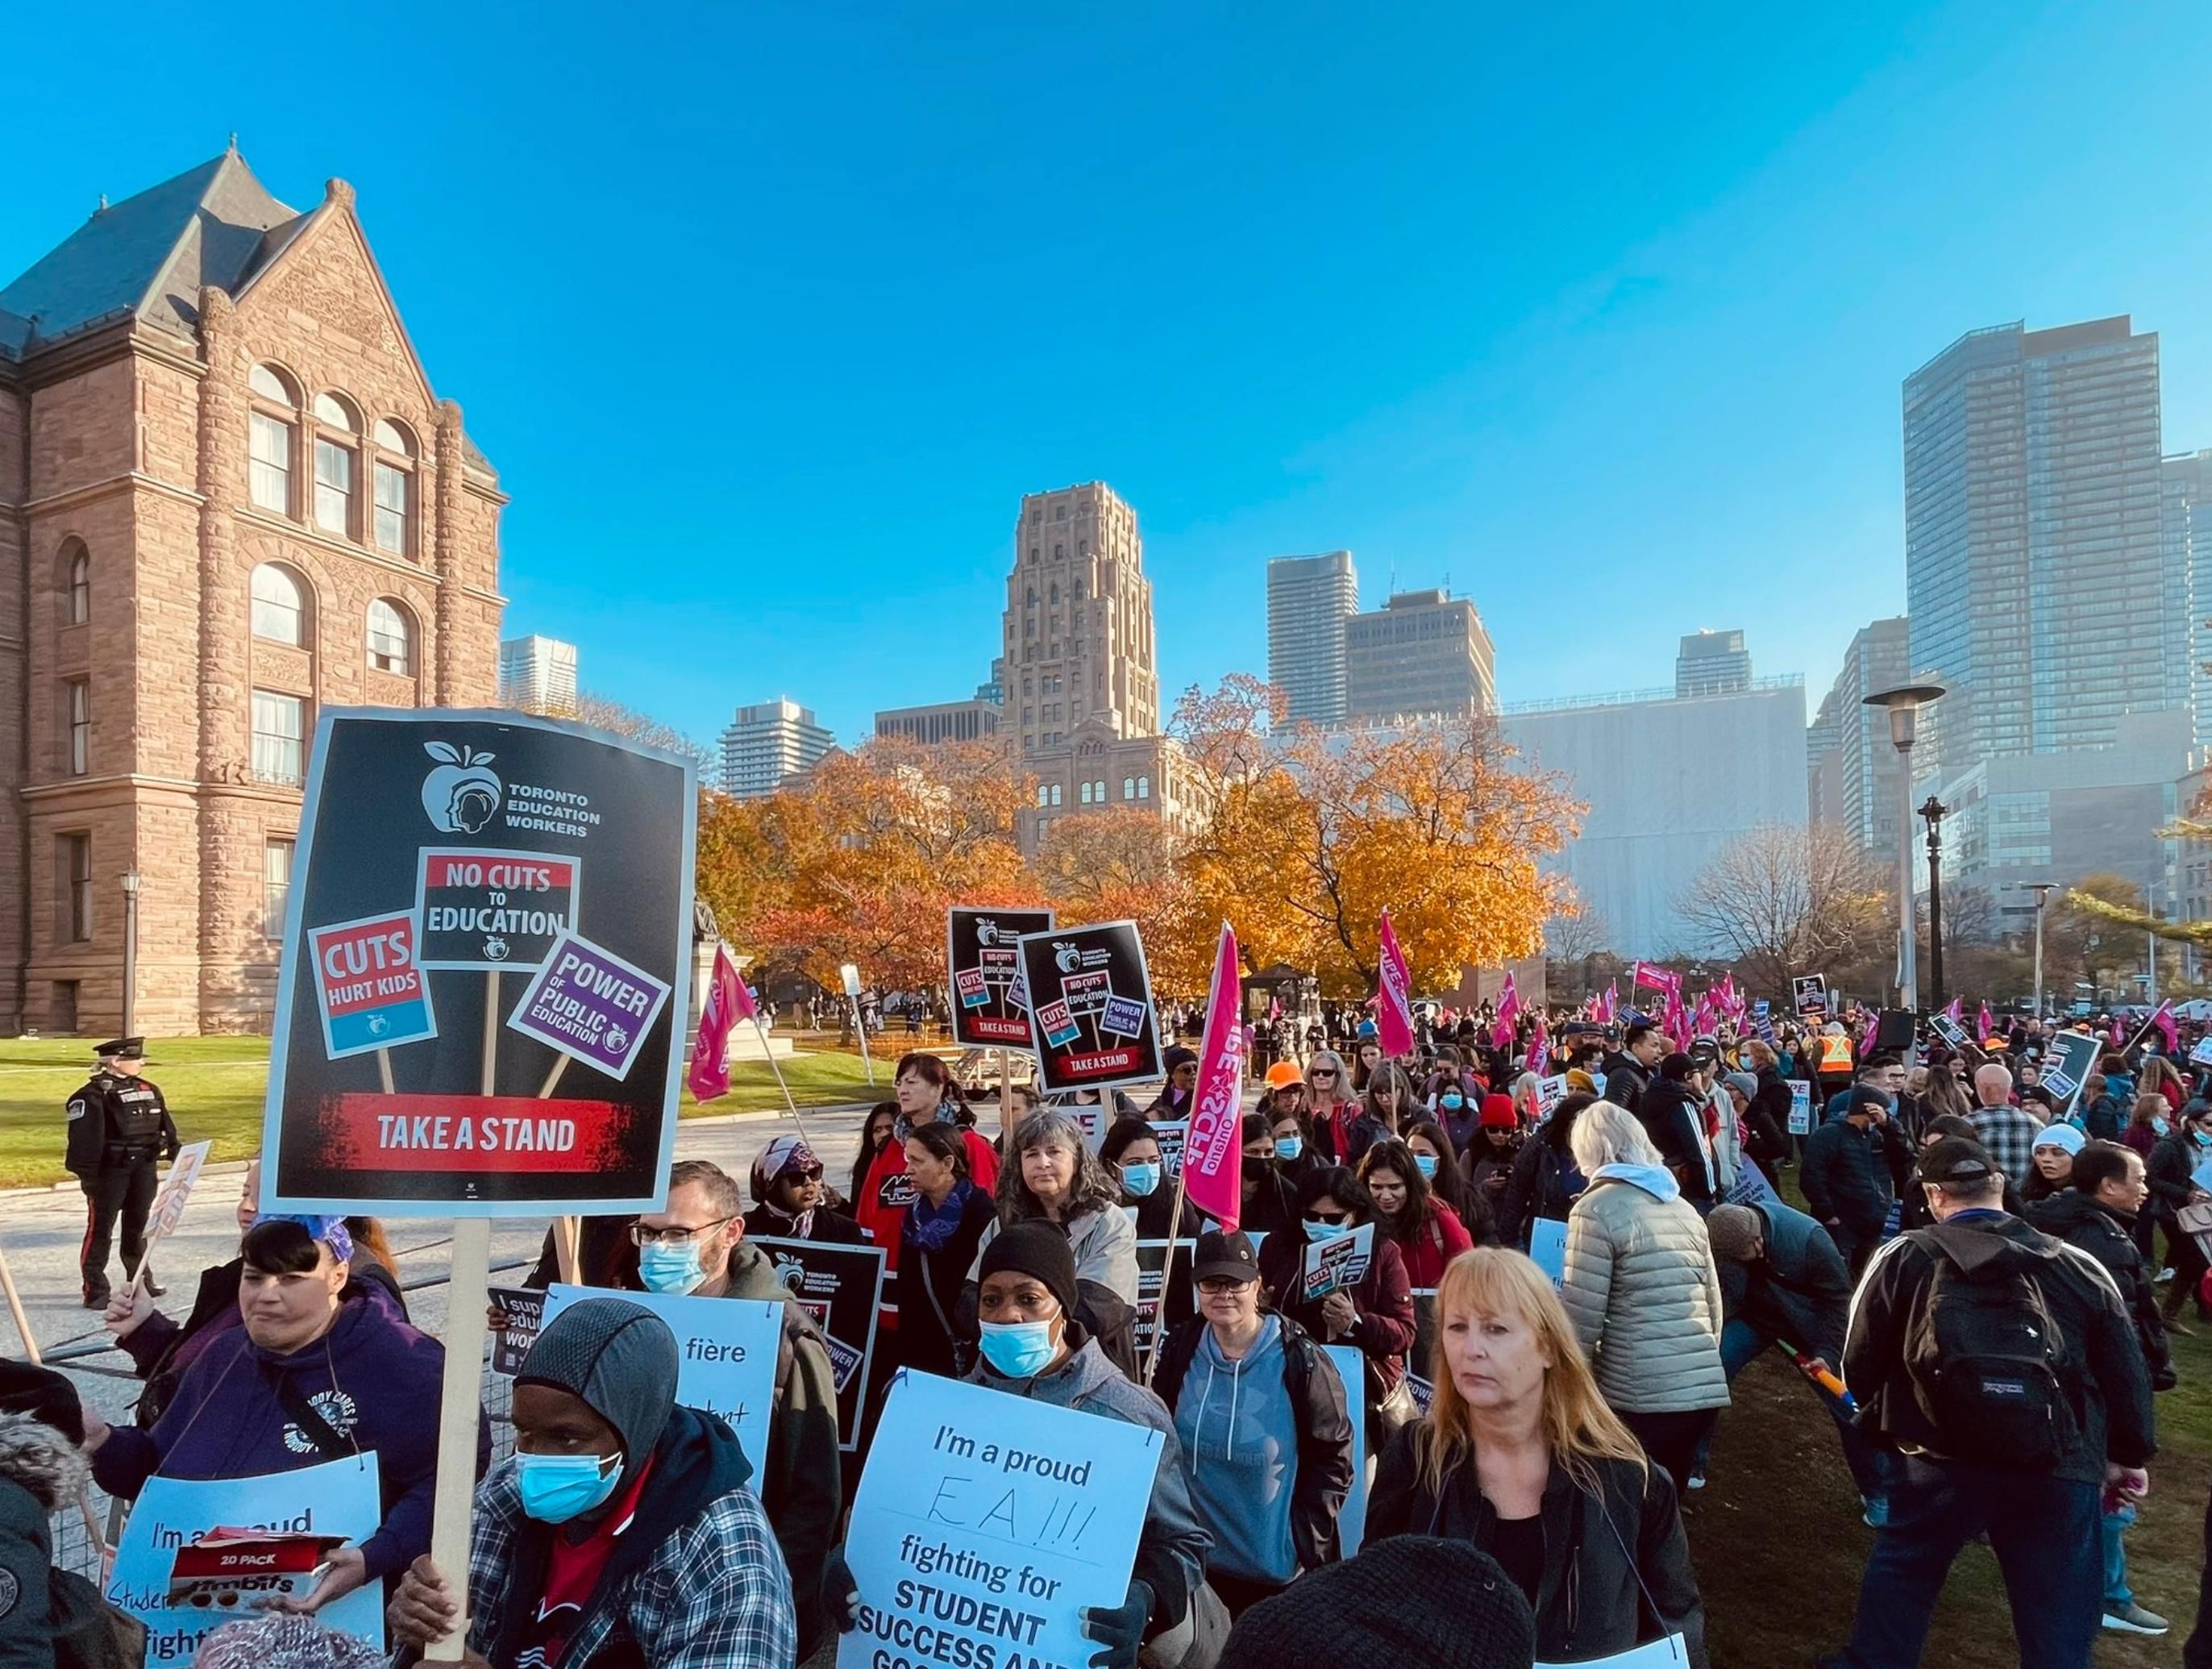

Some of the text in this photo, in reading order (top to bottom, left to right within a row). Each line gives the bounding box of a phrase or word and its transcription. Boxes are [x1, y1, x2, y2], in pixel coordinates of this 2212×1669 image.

[509, 784, 588, 806] TORONTO
[507, 800, 601, 825] EDUCATION
[505, 815, 588, 838] WORKERS
[446, 863, 551, 892] NO CUTS
[489, 892, 506, 905] TO
[428, 907, 564, 936] EDUCATION
[325, 931, 410, 978] CUTS
[329, 972, 417, 1006] HURT KIDS
[550, 976, 566, 988] OF
[556, 953, 649, 1018] POWER
[960, 972, 981, 987] CUTS
[1070, 976, 1102, 990] NO CUTS
[709, 979, 722, 1005] CU
[1068, 989, 1108, 1005] EDUCATION
[539, 987, 607, 1033] PUBLIC
[1042, 1005, 1067, 1024] CUTS
[1110, 1001, 1141, 1017] POWER
[530, 1005, 599, 1046] EDUCATION
[979, 1022, 998, 1033] TAKE
[1004, 1024, 1026, 1035] STAND
[1071, 1054, 1129, 1072] TAKE A STAND
[377, 1115, 576, 1152] TAKE A STAND
[1308, 1267, 1329, 1283] CUTS
[1137, 1305, 1154, 1316] UTS
[686, 1338, 746, 1363] fière
[827, 1344, 855, 1367] OWER
[1407, 1380, 1432, 1401] POWE
[933, 1426, 1091, 1487] I'm a proud
[220, 1554, 276, 1566] 20 PACK
[900, 1534, 1062, 1601] fighting for
[895, 1580, 1047, 1646] STUDENT
[858, 1605, 996, 1669] SUCCESS
